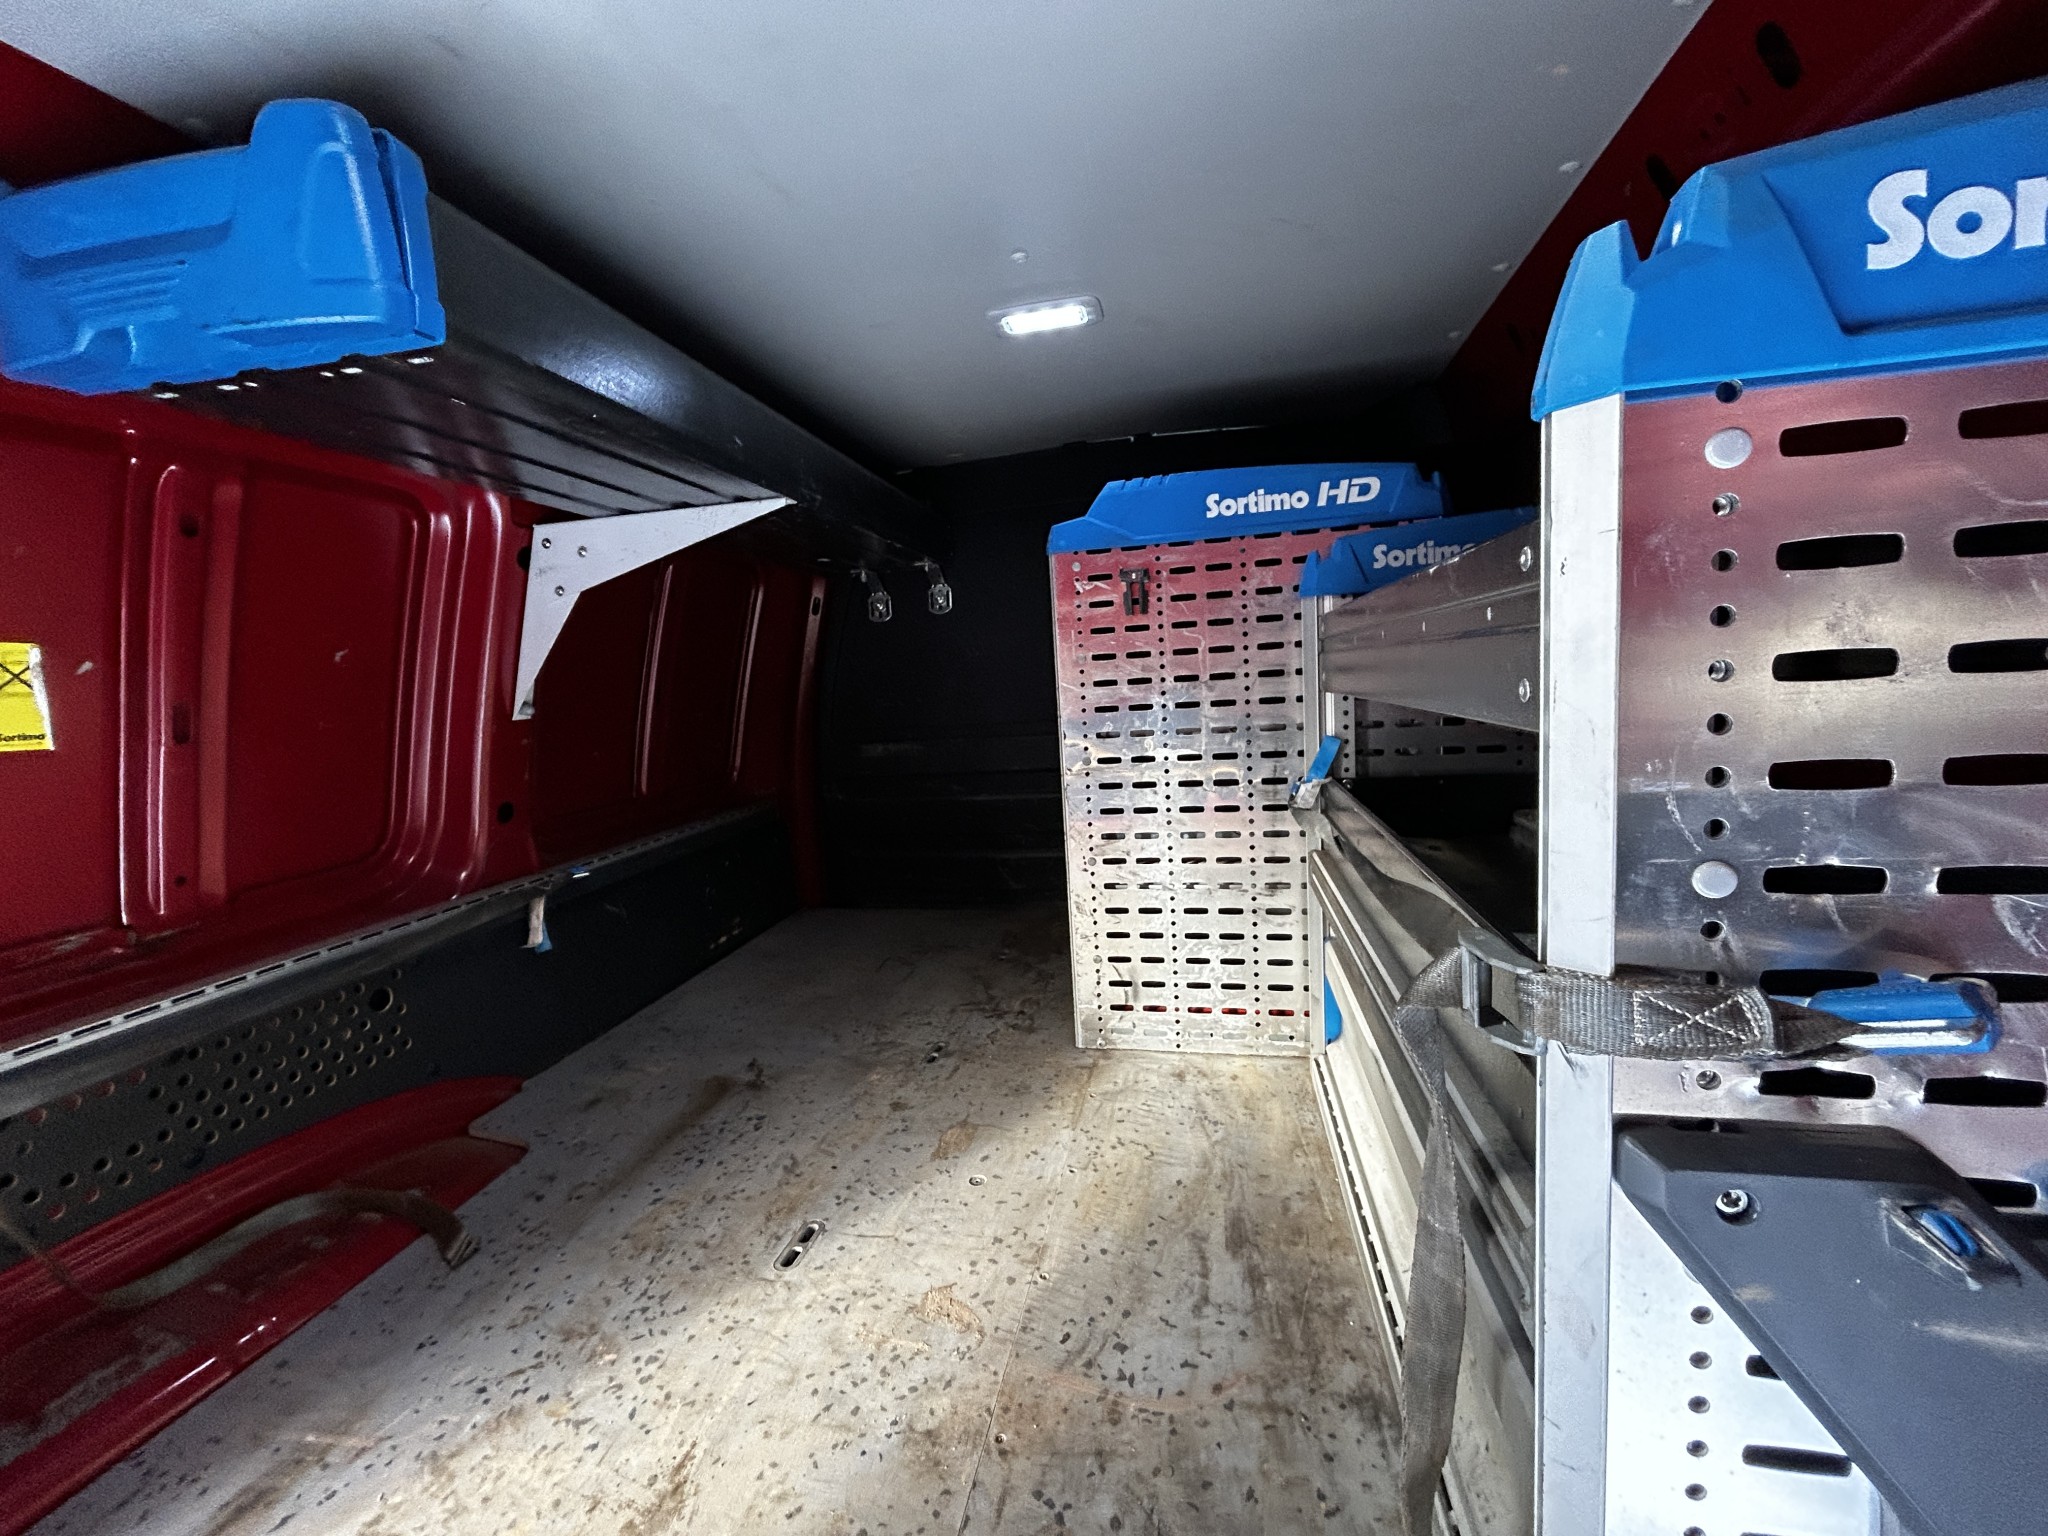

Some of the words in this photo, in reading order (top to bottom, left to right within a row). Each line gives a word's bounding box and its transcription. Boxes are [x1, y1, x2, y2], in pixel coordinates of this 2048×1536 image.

[1206, 488, 1310, 518] Sortimo
[1316, 476, 1381, 506] HD
[1373, 540, 1475, 569] Sortim
